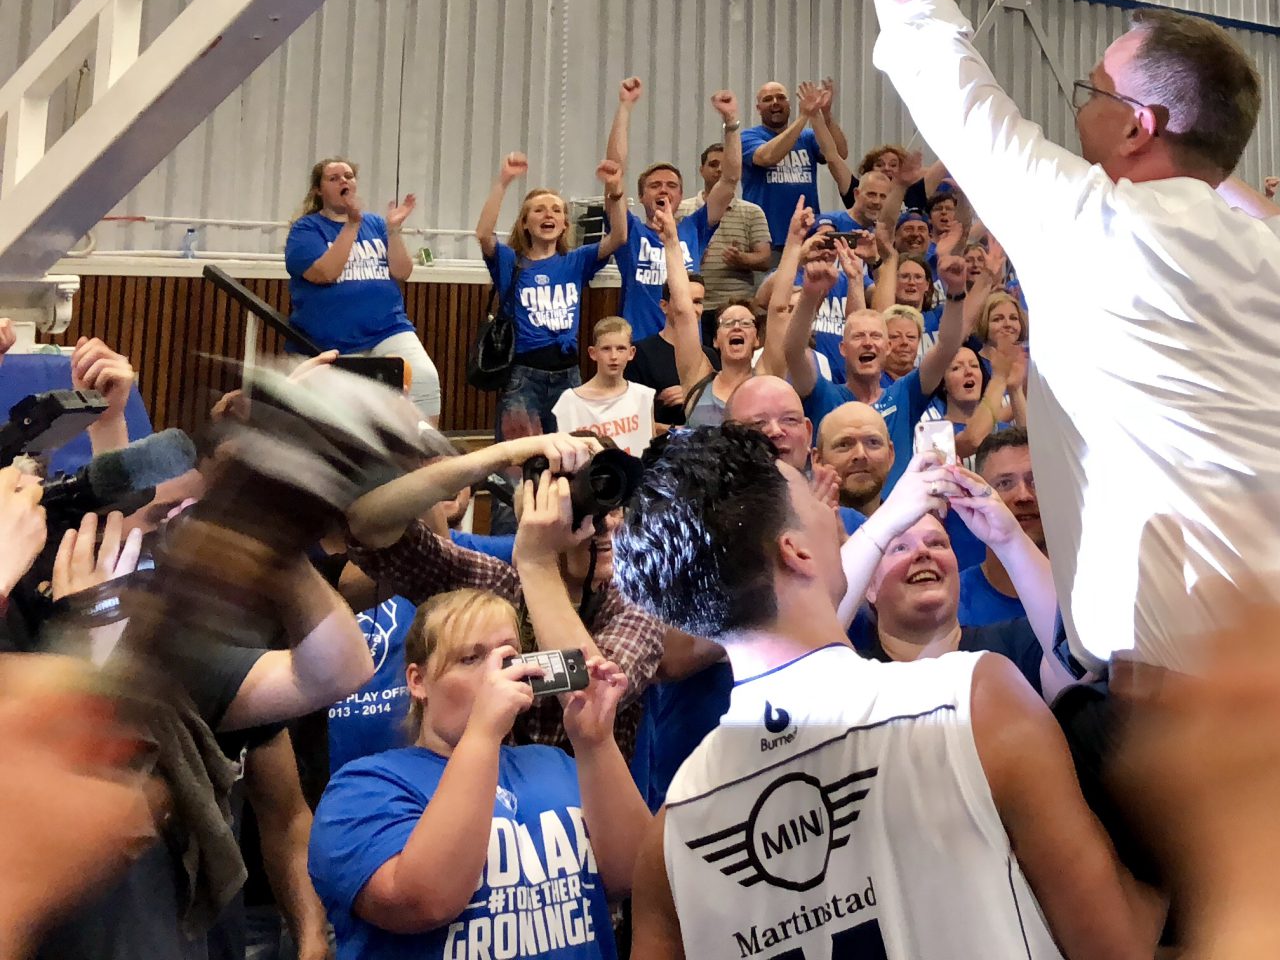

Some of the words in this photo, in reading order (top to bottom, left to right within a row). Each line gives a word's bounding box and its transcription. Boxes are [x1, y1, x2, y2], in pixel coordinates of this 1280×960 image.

[346, 691, 379, 704] PLAY
[381, 686, 411, 700] OFF
[328, 706, 351, 718] 013
[362, 702, 391, 715] 2014
[443, 897, 596, 960] GRONINGE
